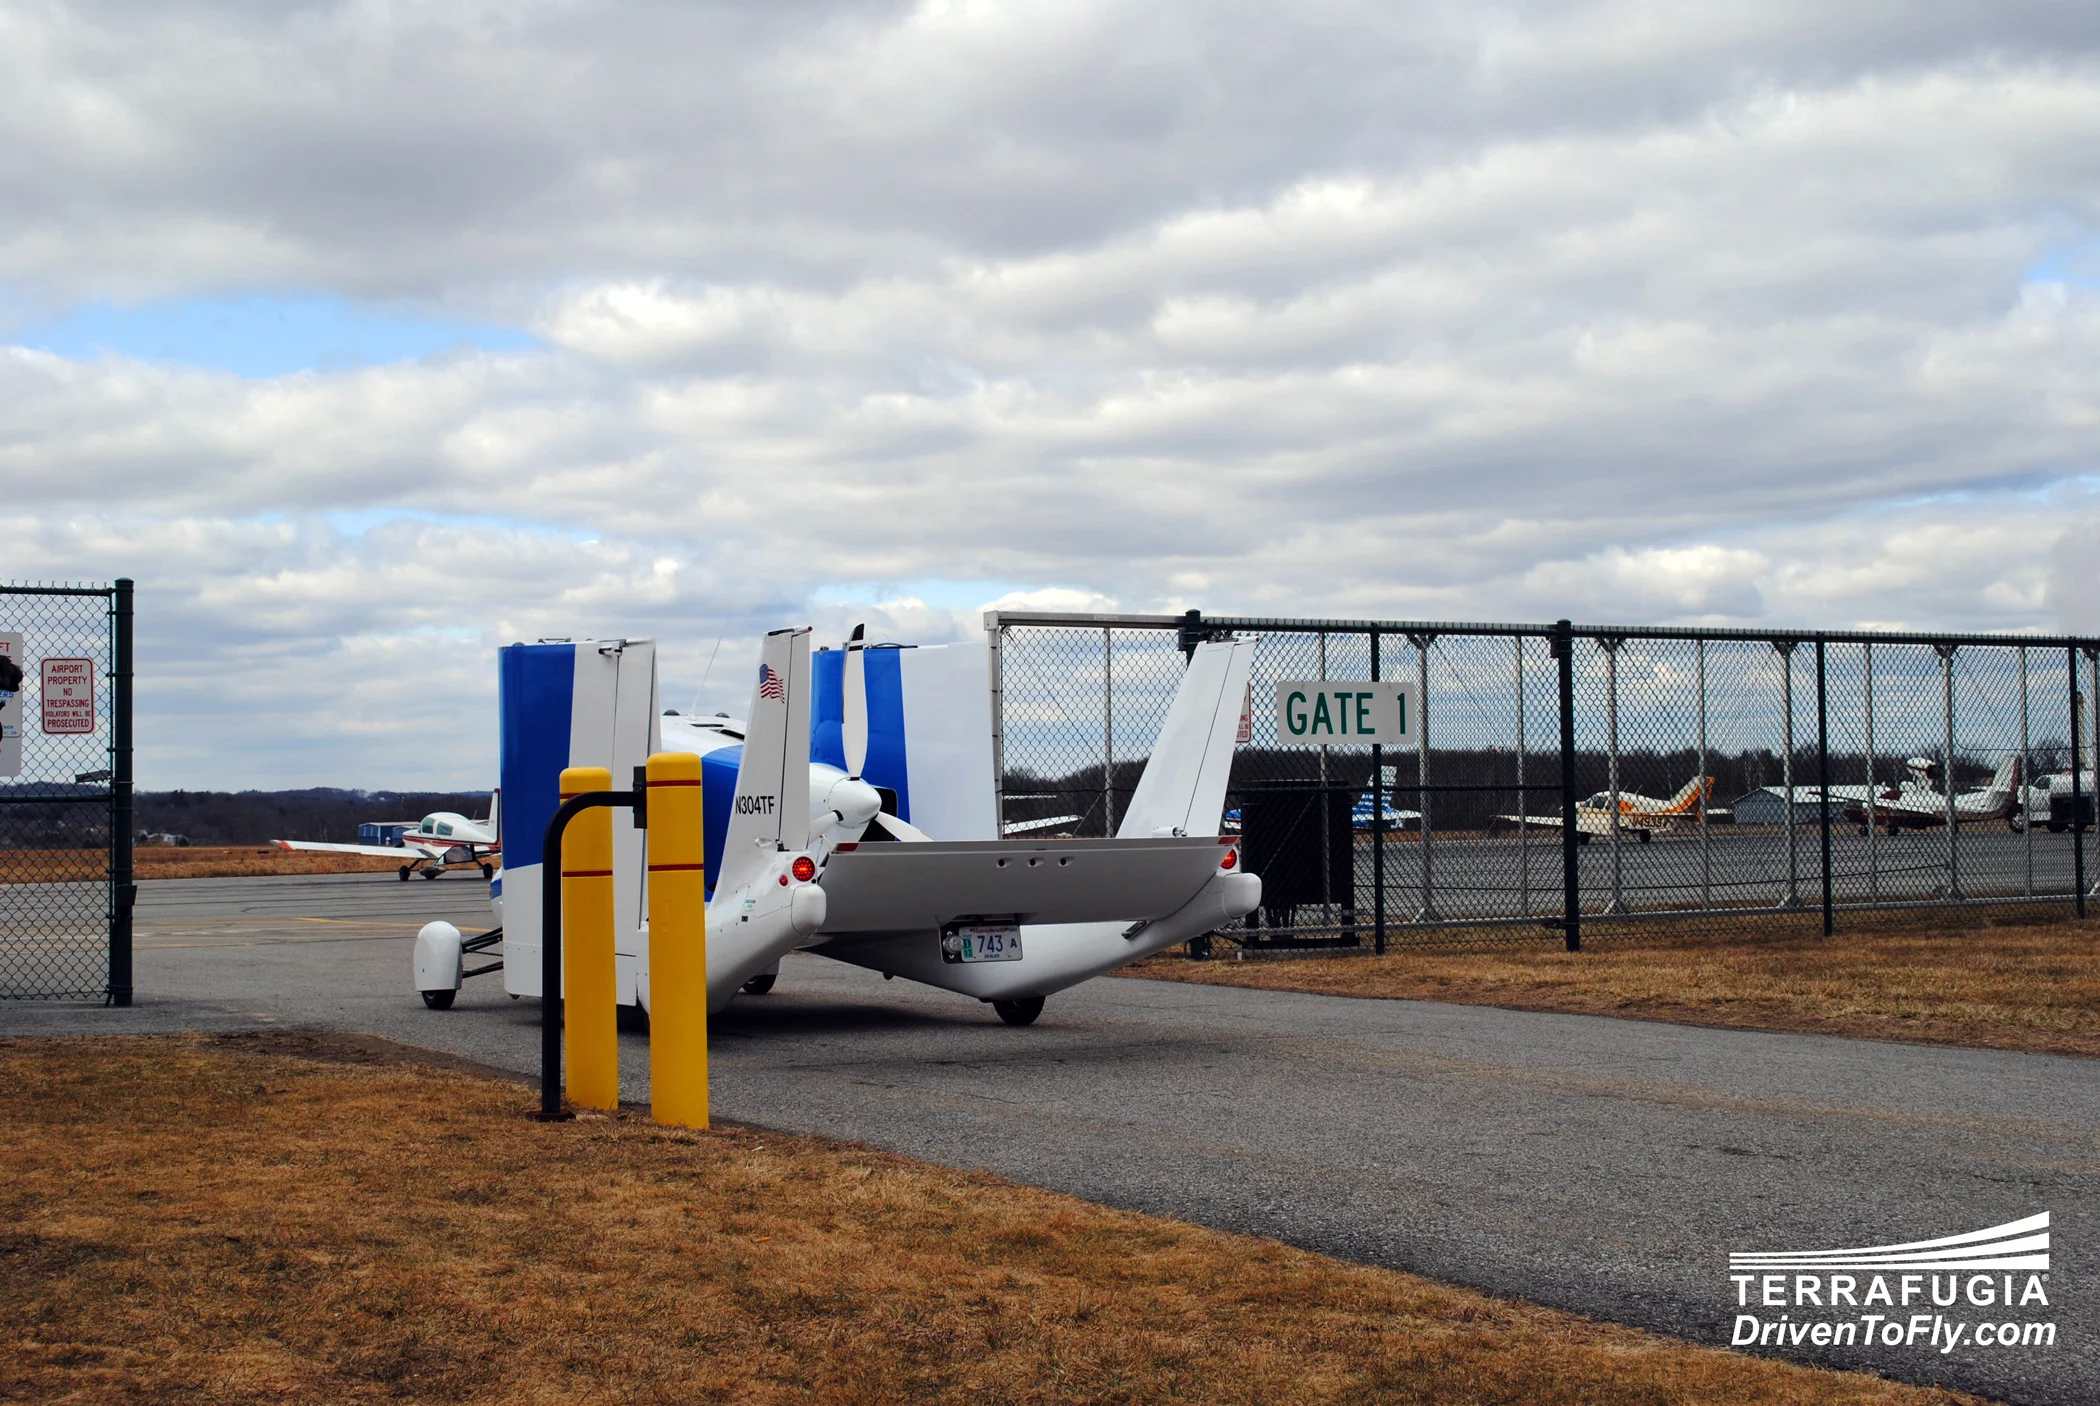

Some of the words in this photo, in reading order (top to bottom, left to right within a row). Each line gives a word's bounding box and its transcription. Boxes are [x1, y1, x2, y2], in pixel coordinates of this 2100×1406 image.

[51, 664, 84, 673] AIRPORT
[47, 676, 88, 685] PROPERTY
[63, 687, 73, 696] NO
[46, 699, 90, 708] TRESPASSING
[1286, 691, 1376, 735] GATE
[1397, 692, 1406, 735] 1
[47, 719, 90, 728] PROSECUTED
[735, 795, 775, 815] N304TF
[977, 934, 1004, 954] 743
[1010, 937, 1018, 948] A
